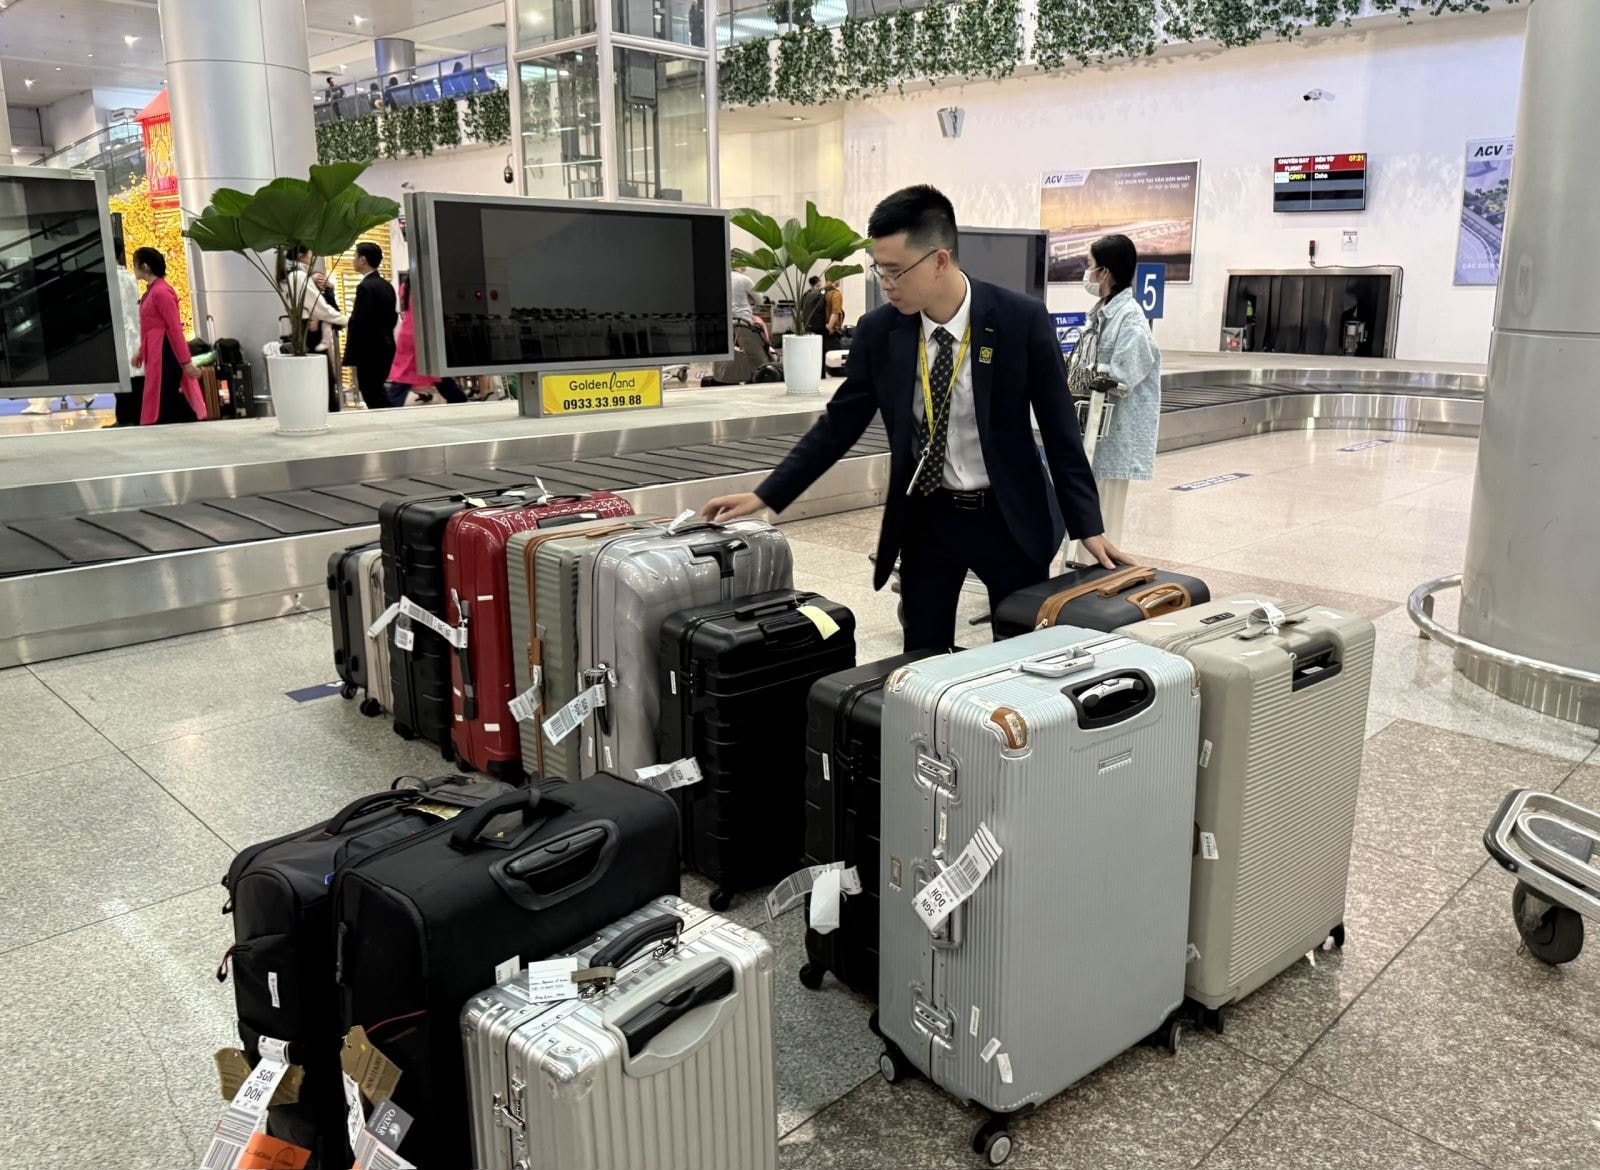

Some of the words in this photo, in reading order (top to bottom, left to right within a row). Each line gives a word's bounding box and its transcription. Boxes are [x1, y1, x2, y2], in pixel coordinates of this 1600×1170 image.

[1474, 145, 1504, 157] ACV
[1044, 174, 1063, 184] ACV
[1142, 273, 1157, 311] 5
[1056, 317, 1067, 325] TIA
[563, 395, 642, 410] 0933.33.99.88
[930, 888, 946, 907] DOH
[921, 898, 935, 917] SGN
[256, 1069, 276, 1083] SGN
[243, 1086, 264, 1101] DOH
[376, 1109, 397, 1136] QATAR
